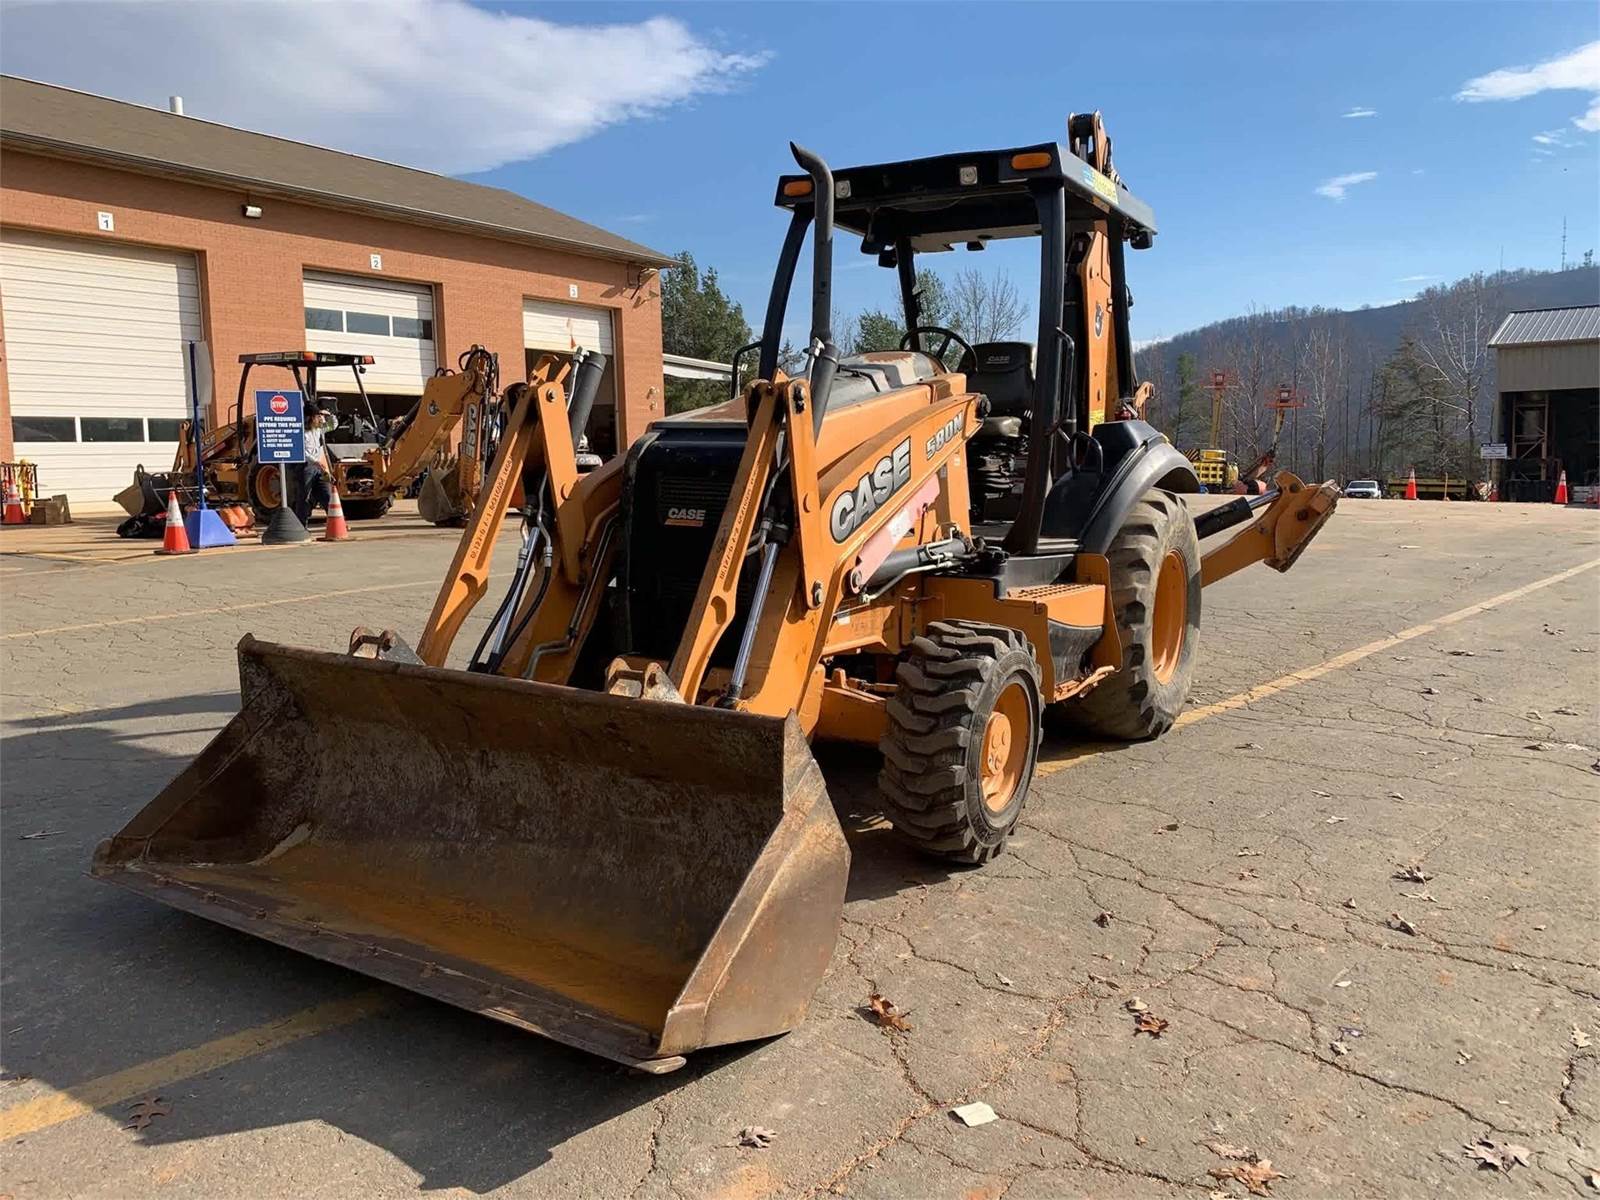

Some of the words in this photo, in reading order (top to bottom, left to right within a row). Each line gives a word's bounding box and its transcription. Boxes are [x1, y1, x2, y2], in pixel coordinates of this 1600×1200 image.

[103, 219, 109, 229] 1
[373, 259, 379, 268] 2
[466, 403, 477, 459] CASE
[926, 410, 964, 460] 580N
[830, 436, 912, 543] CASE
[668, 507, 706, 520] CASE
